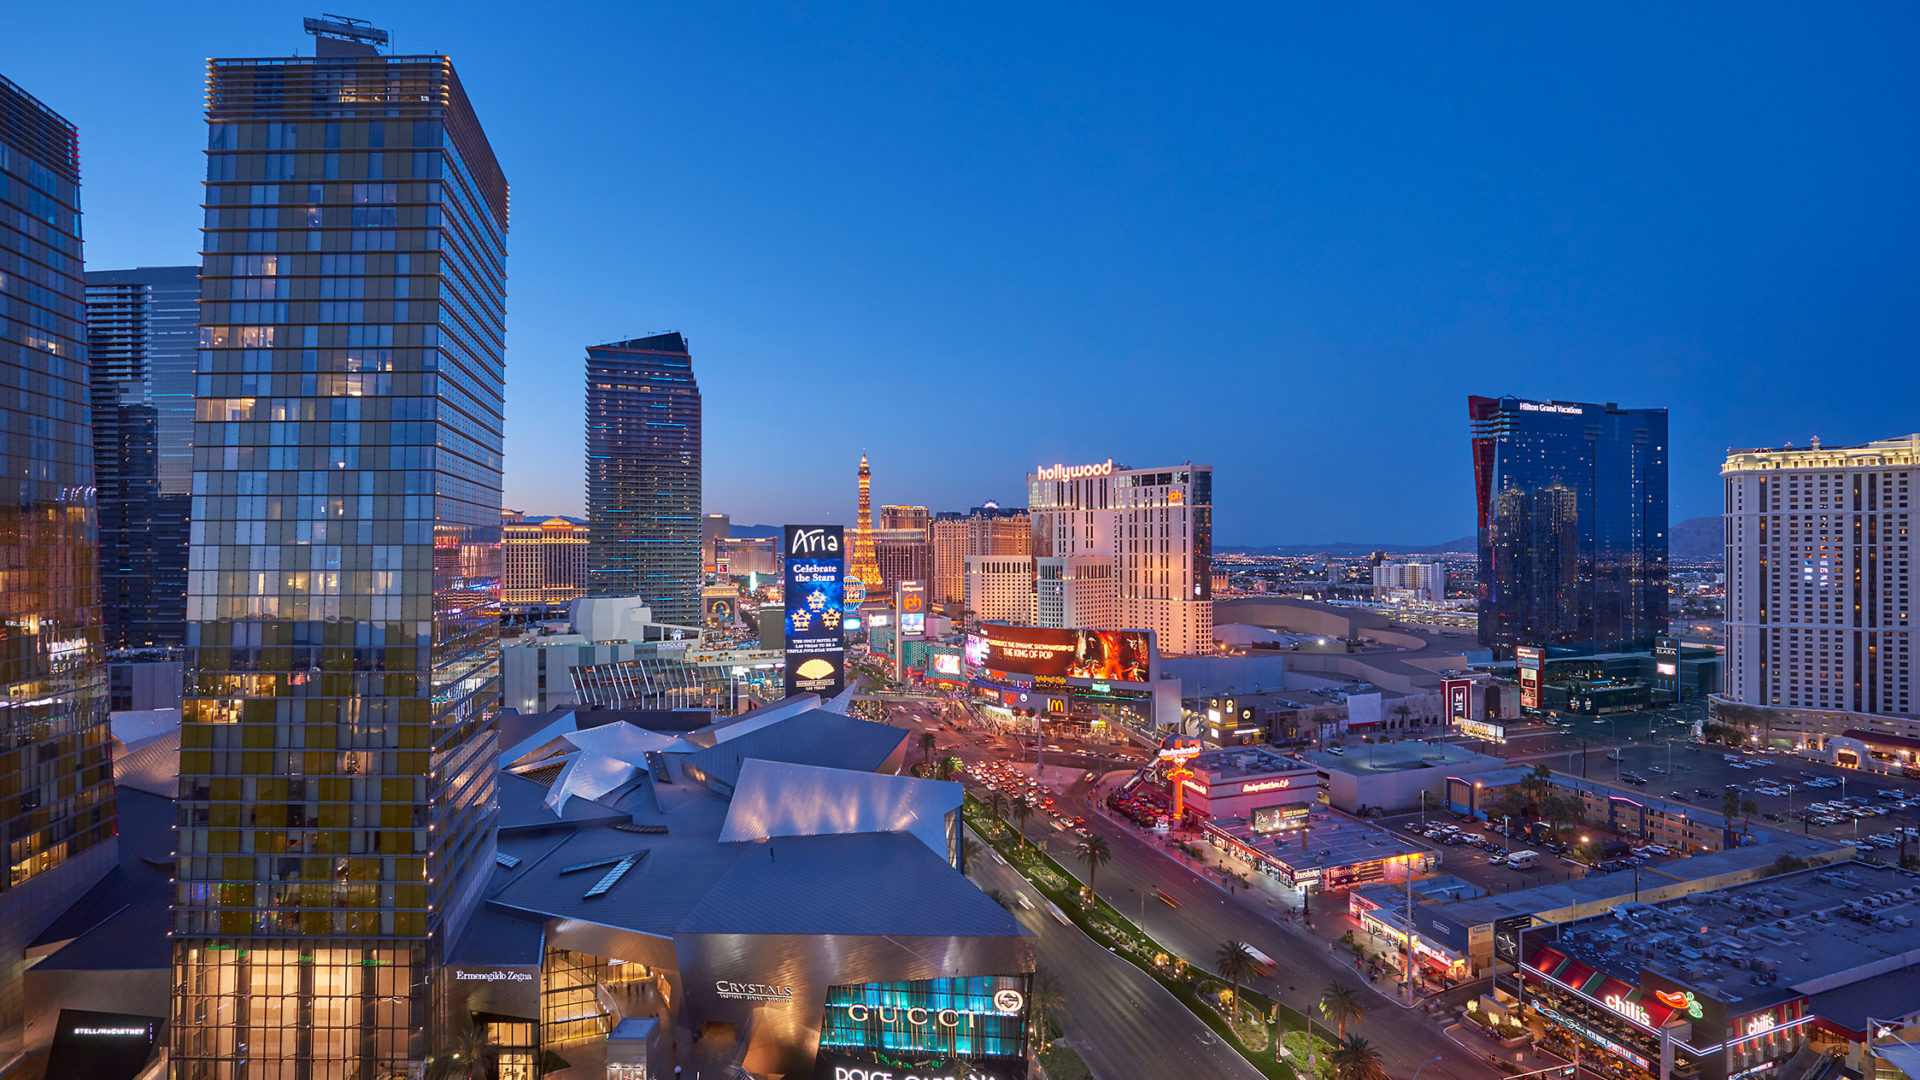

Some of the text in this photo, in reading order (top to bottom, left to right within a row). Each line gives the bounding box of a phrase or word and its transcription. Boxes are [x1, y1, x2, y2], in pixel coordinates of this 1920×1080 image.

[1520, 403, 1582, 414] Hilton Grand Vacations
[1037, 459, 1112, 482] hollywood
[792, 529, 838, 554] Aria
[793, 564, 837, 573] Celebrate
[795, 573, 836, 582] the Stars
[1003, 648, 1053, 659] THE KING OF POP
[507, 971, 532, 983] Zegna
[715, 980, 792, 996] CRYSTALS
[848, 1003, 975, 1029] GUCCI
[1605, 994, 1651, 1027] chili's
